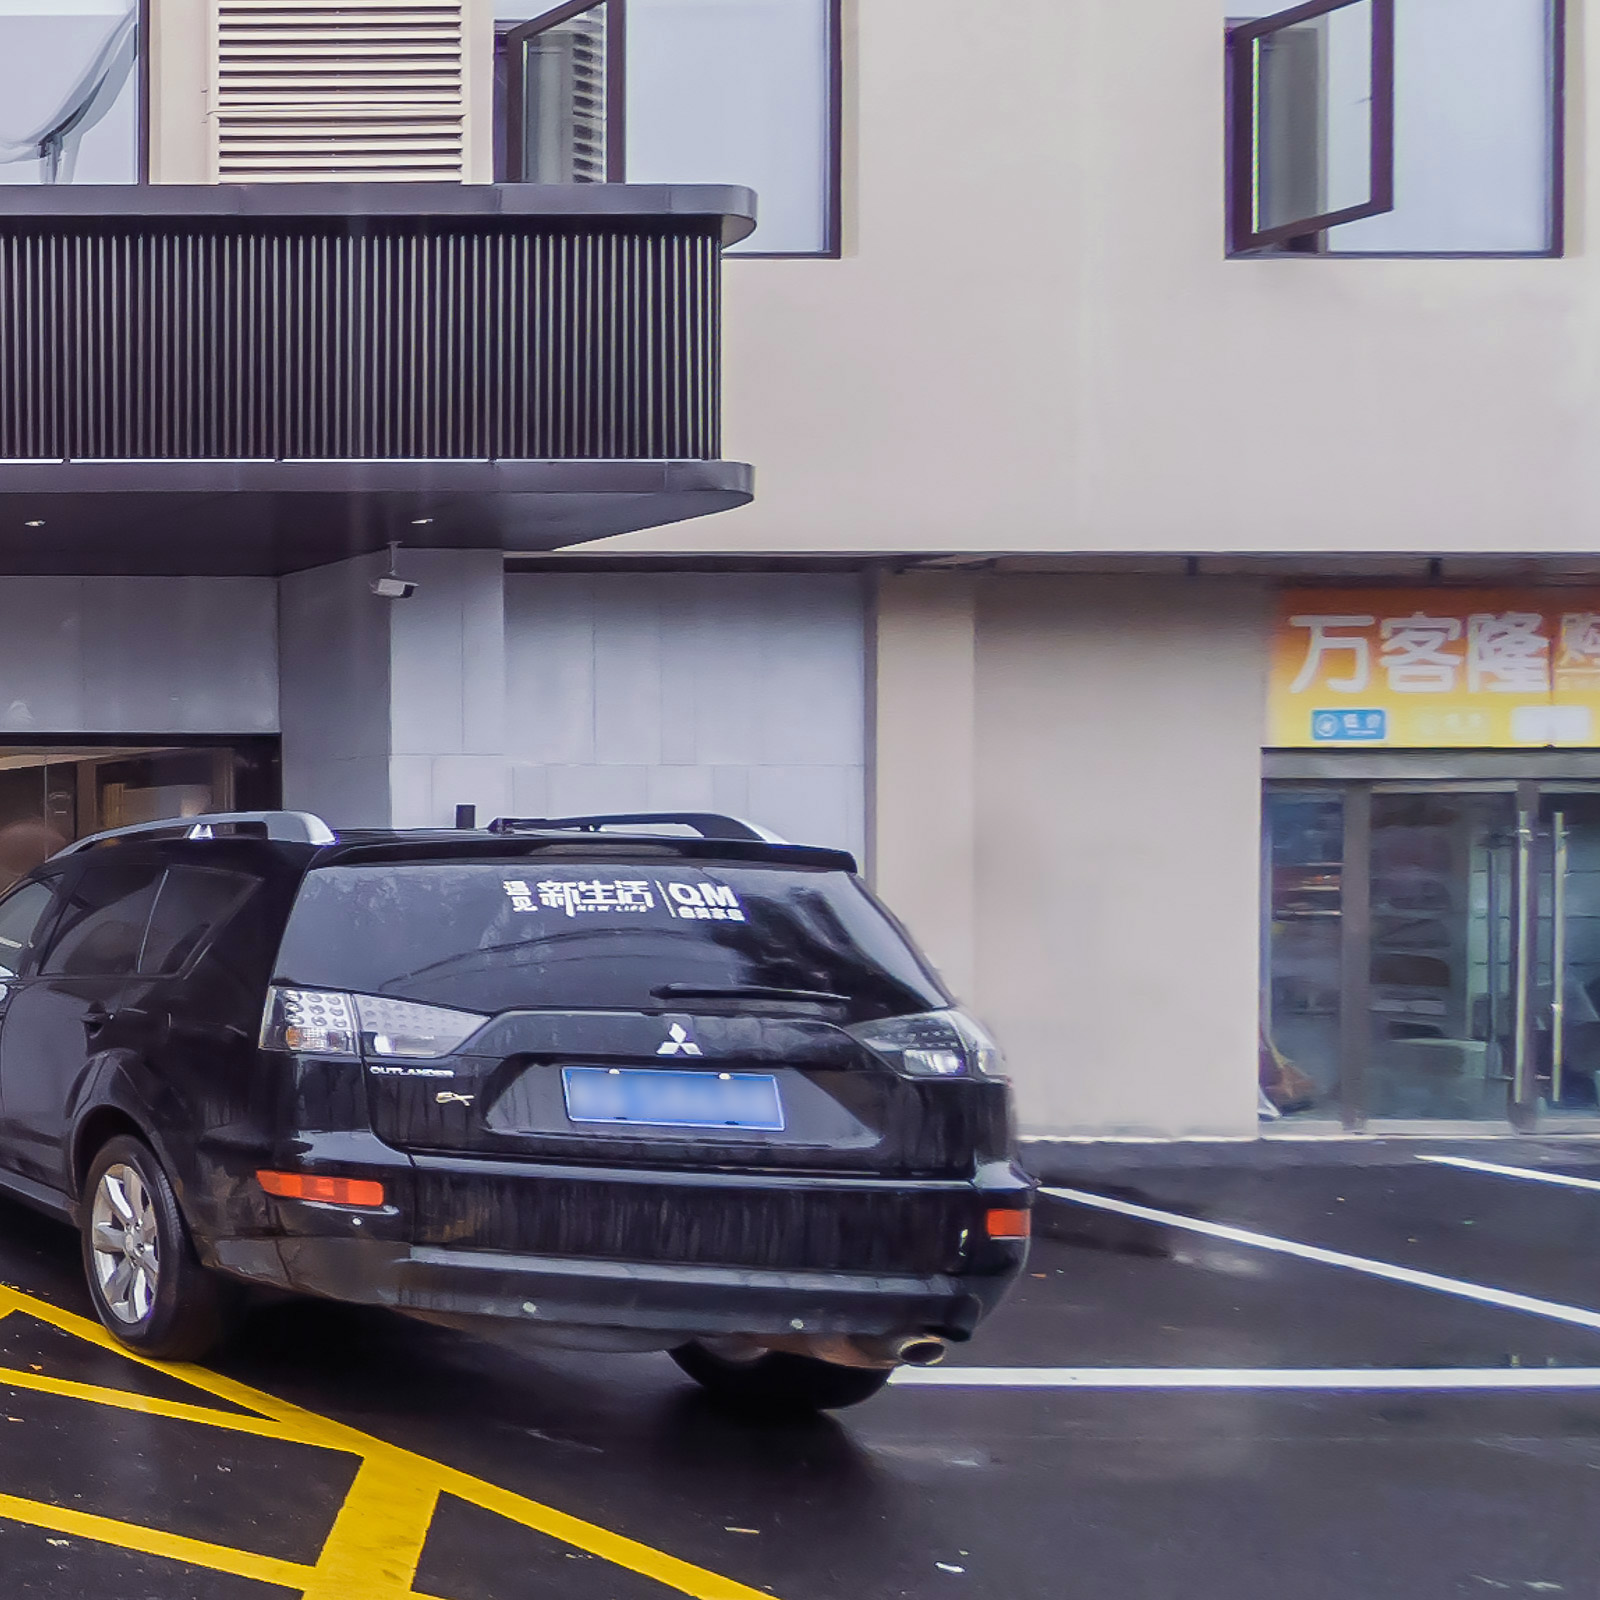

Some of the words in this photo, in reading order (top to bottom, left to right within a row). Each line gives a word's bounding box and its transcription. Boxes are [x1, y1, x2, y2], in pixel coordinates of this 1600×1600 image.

[536, 880, 656, 917] 新生活
[668, 882, 740, 907] QM
